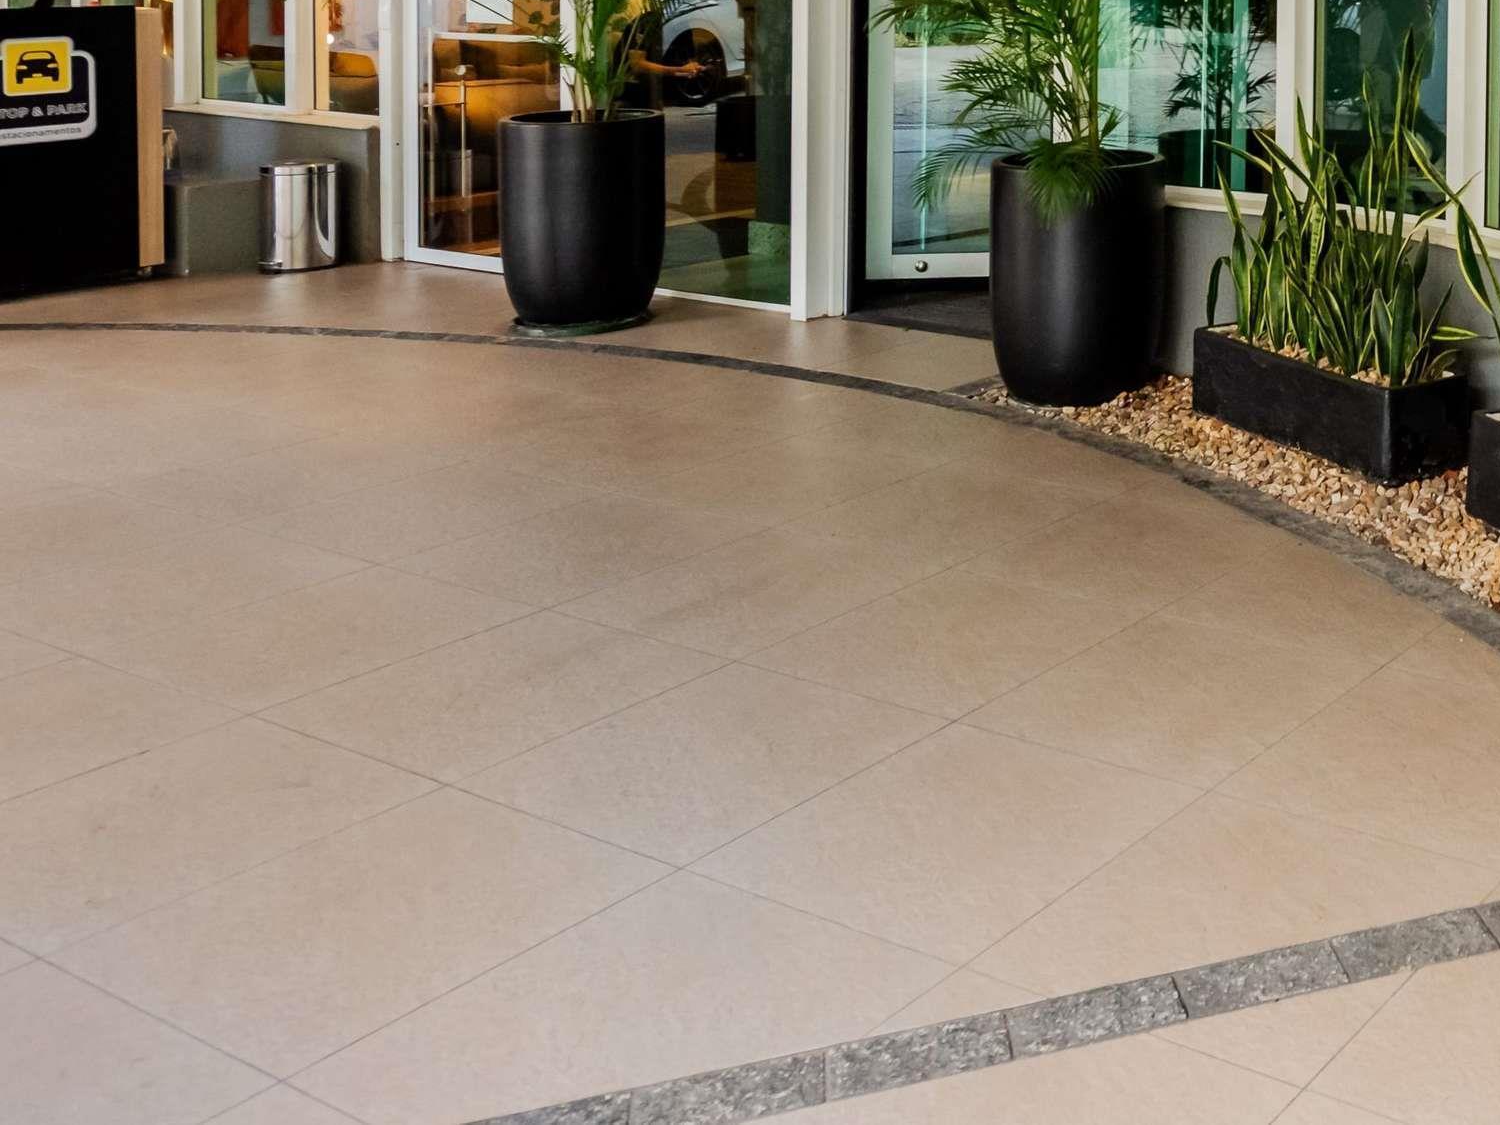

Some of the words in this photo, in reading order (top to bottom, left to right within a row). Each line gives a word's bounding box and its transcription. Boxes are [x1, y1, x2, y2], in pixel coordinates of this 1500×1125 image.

[32, 106, 44, 117] &
[47, 103, 87, 116] PARK
[0, 128, 81, 139] stacionamentos
